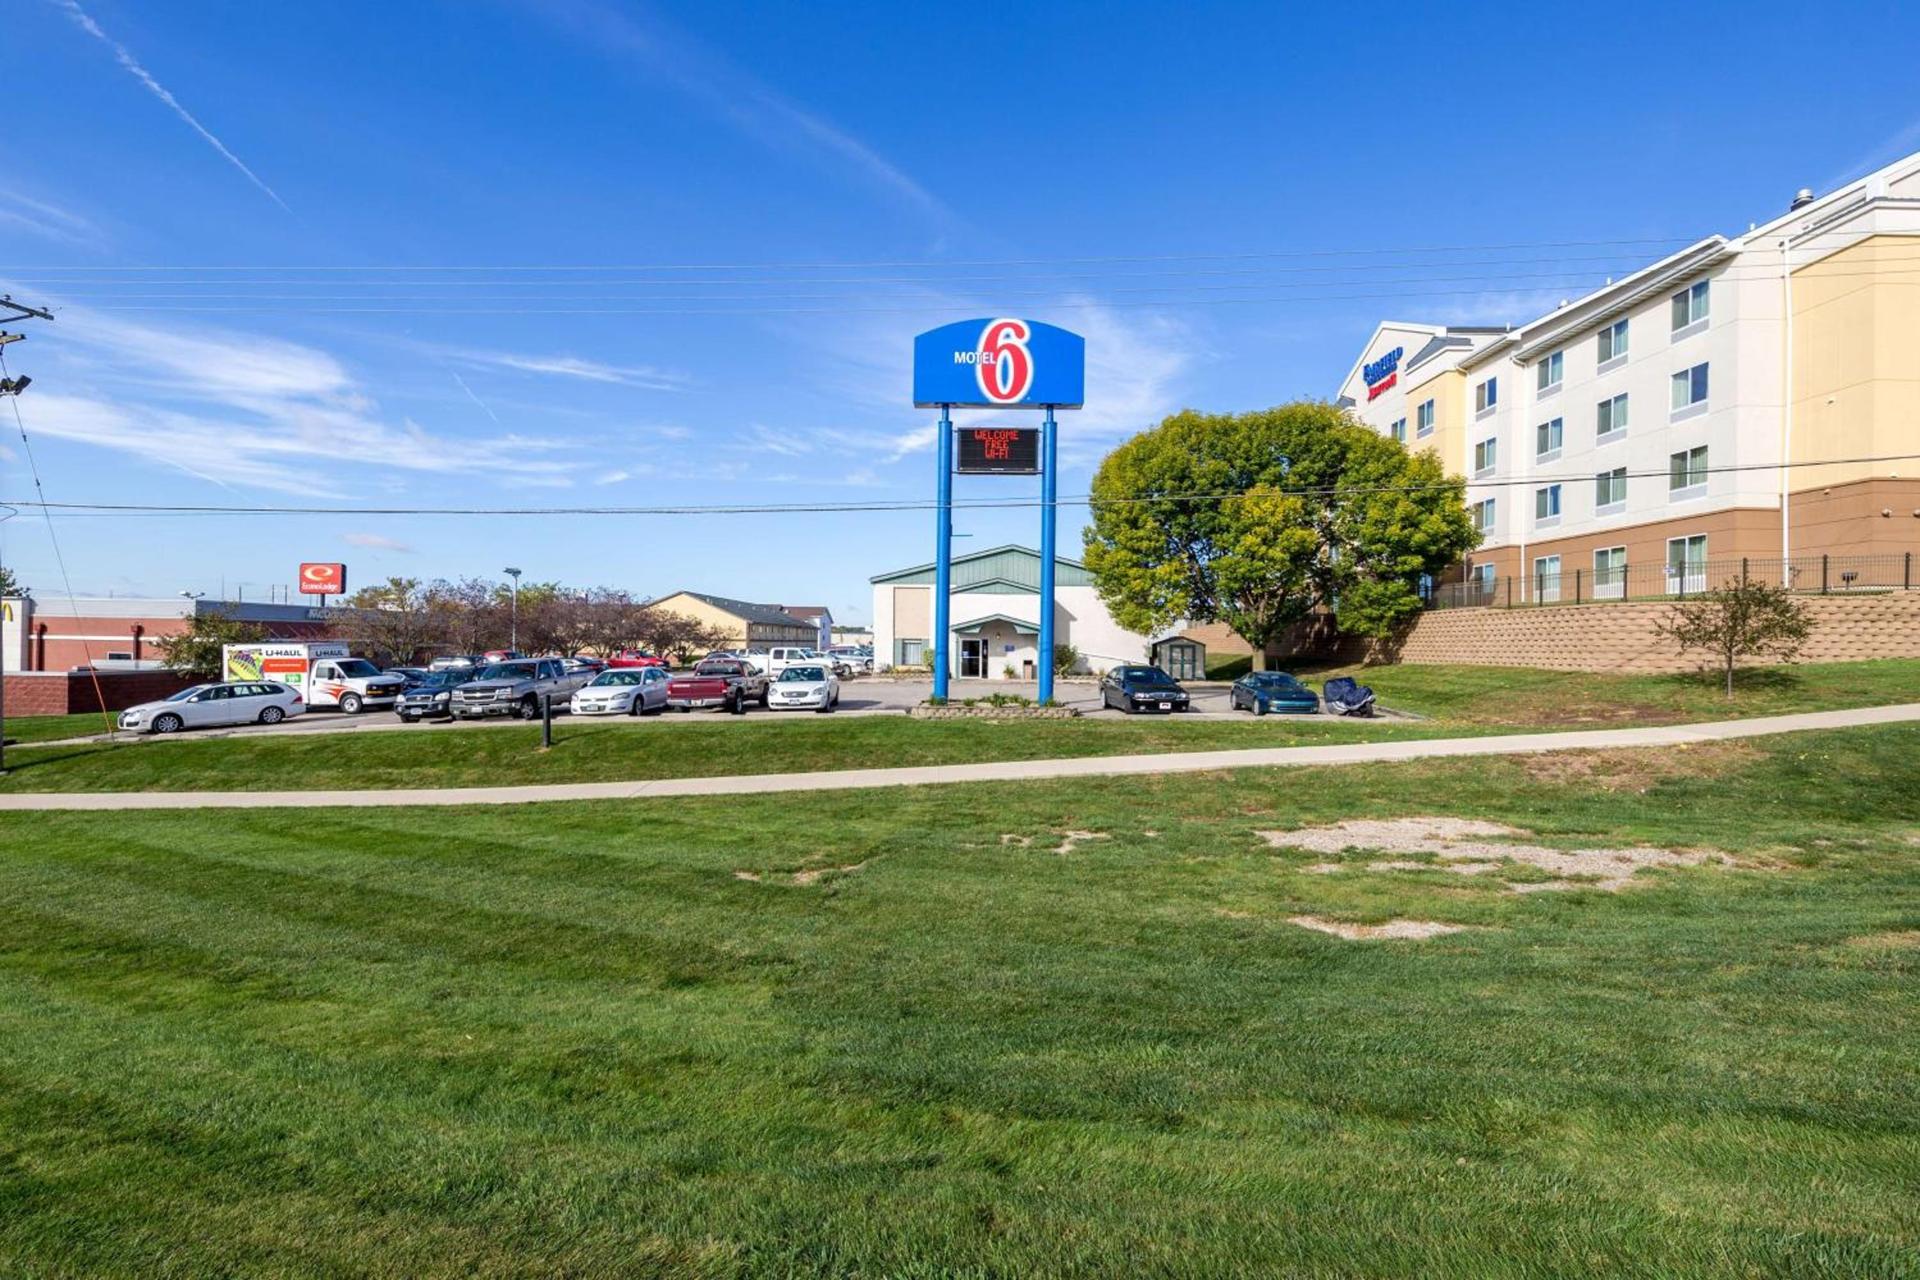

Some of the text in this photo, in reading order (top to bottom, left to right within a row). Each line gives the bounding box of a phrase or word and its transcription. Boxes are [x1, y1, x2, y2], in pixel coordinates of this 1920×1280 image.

[954, 318, 1034, 403] MOTEL 6
[975, 430, 1020, 440] WELCOME
[984, 440, 1009, 449] FREE
[315, 649, 345, 657] U-HAUL
